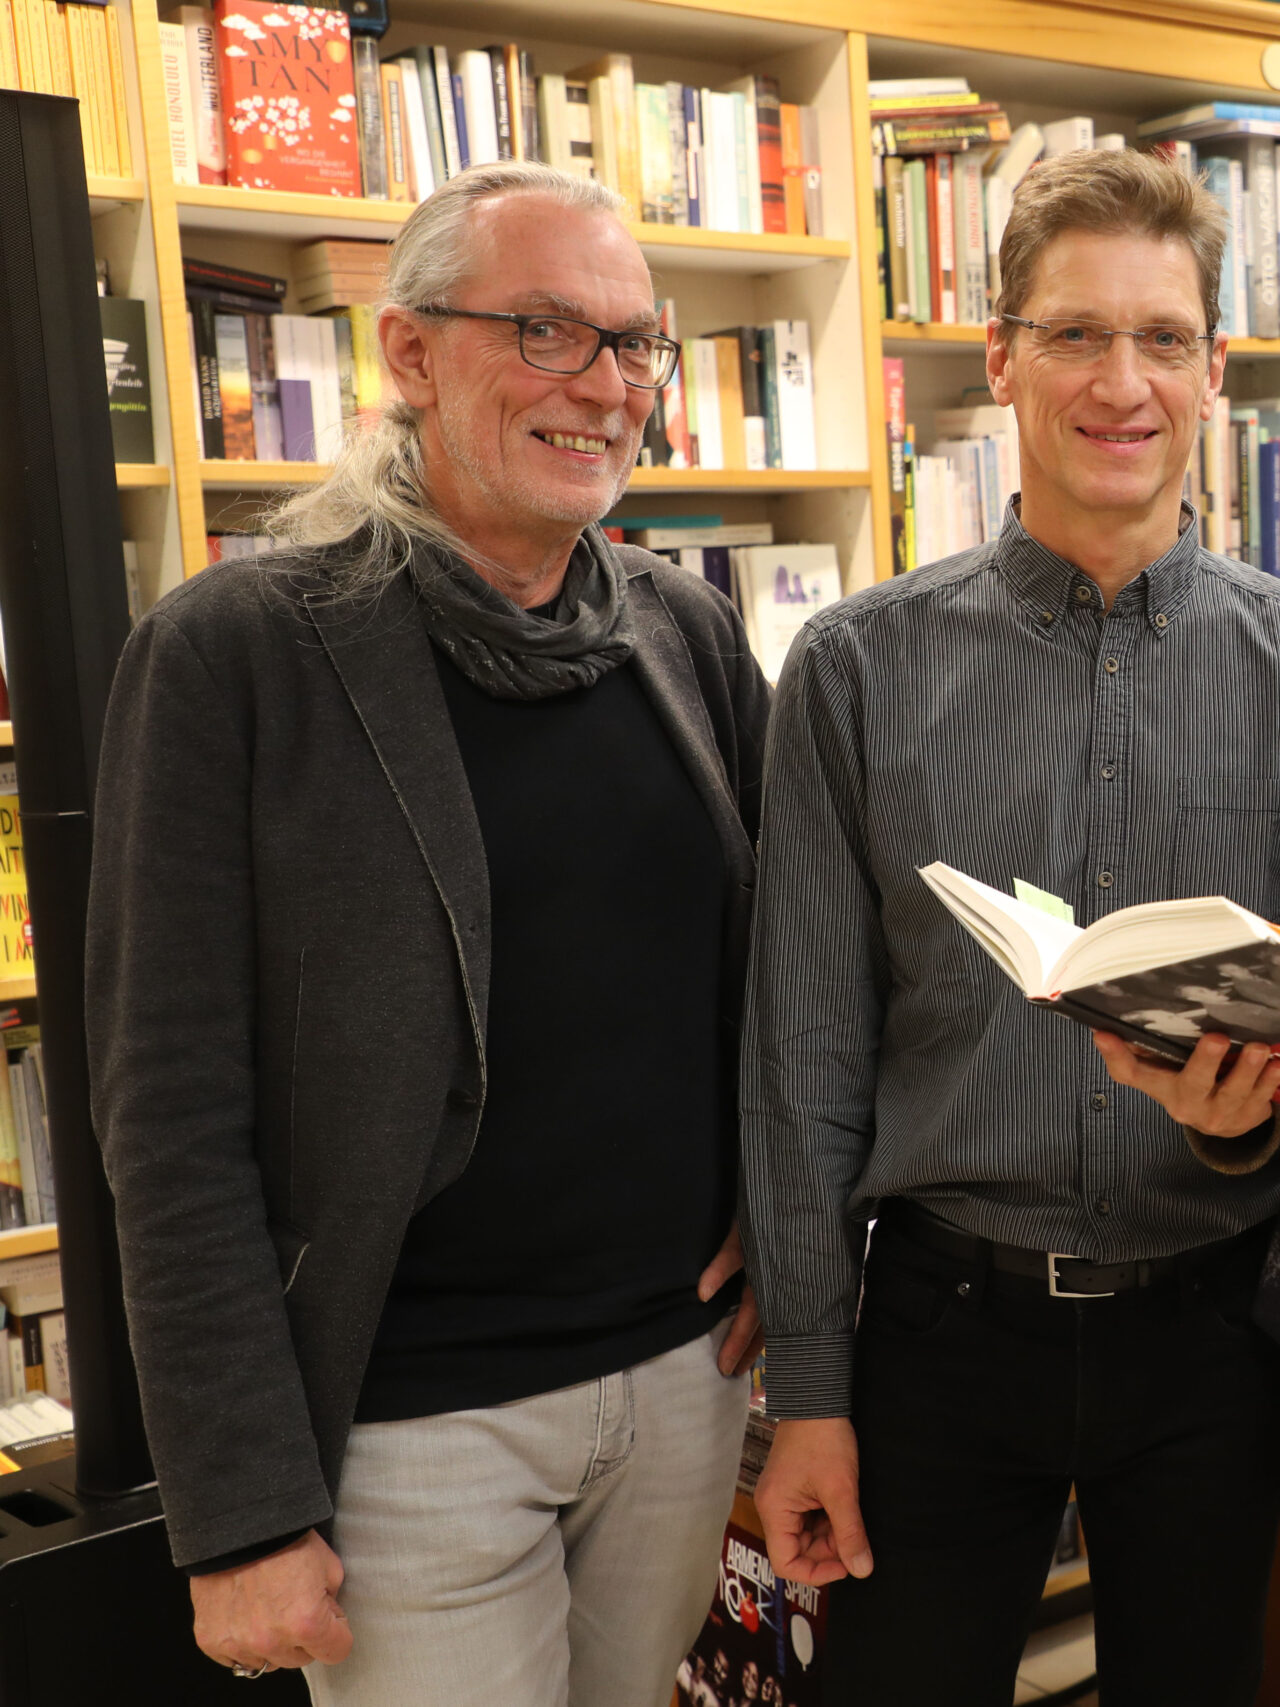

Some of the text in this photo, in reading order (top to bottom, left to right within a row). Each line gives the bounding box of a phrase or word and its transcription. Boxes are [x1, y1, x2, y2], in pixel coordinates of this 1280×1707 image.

[239, 32, 329, 63] AMY
[164, 54, 184, 123] HONOLULU
[198, 27, 219, 112] MUTTERLAND
[238, 59, 331, 93] TAN
[171, 127, 187, 168] HOTEL
[1261, 254, 1276, 305] OTTO
[784, 1578, 821, 1616] SPIRIT
